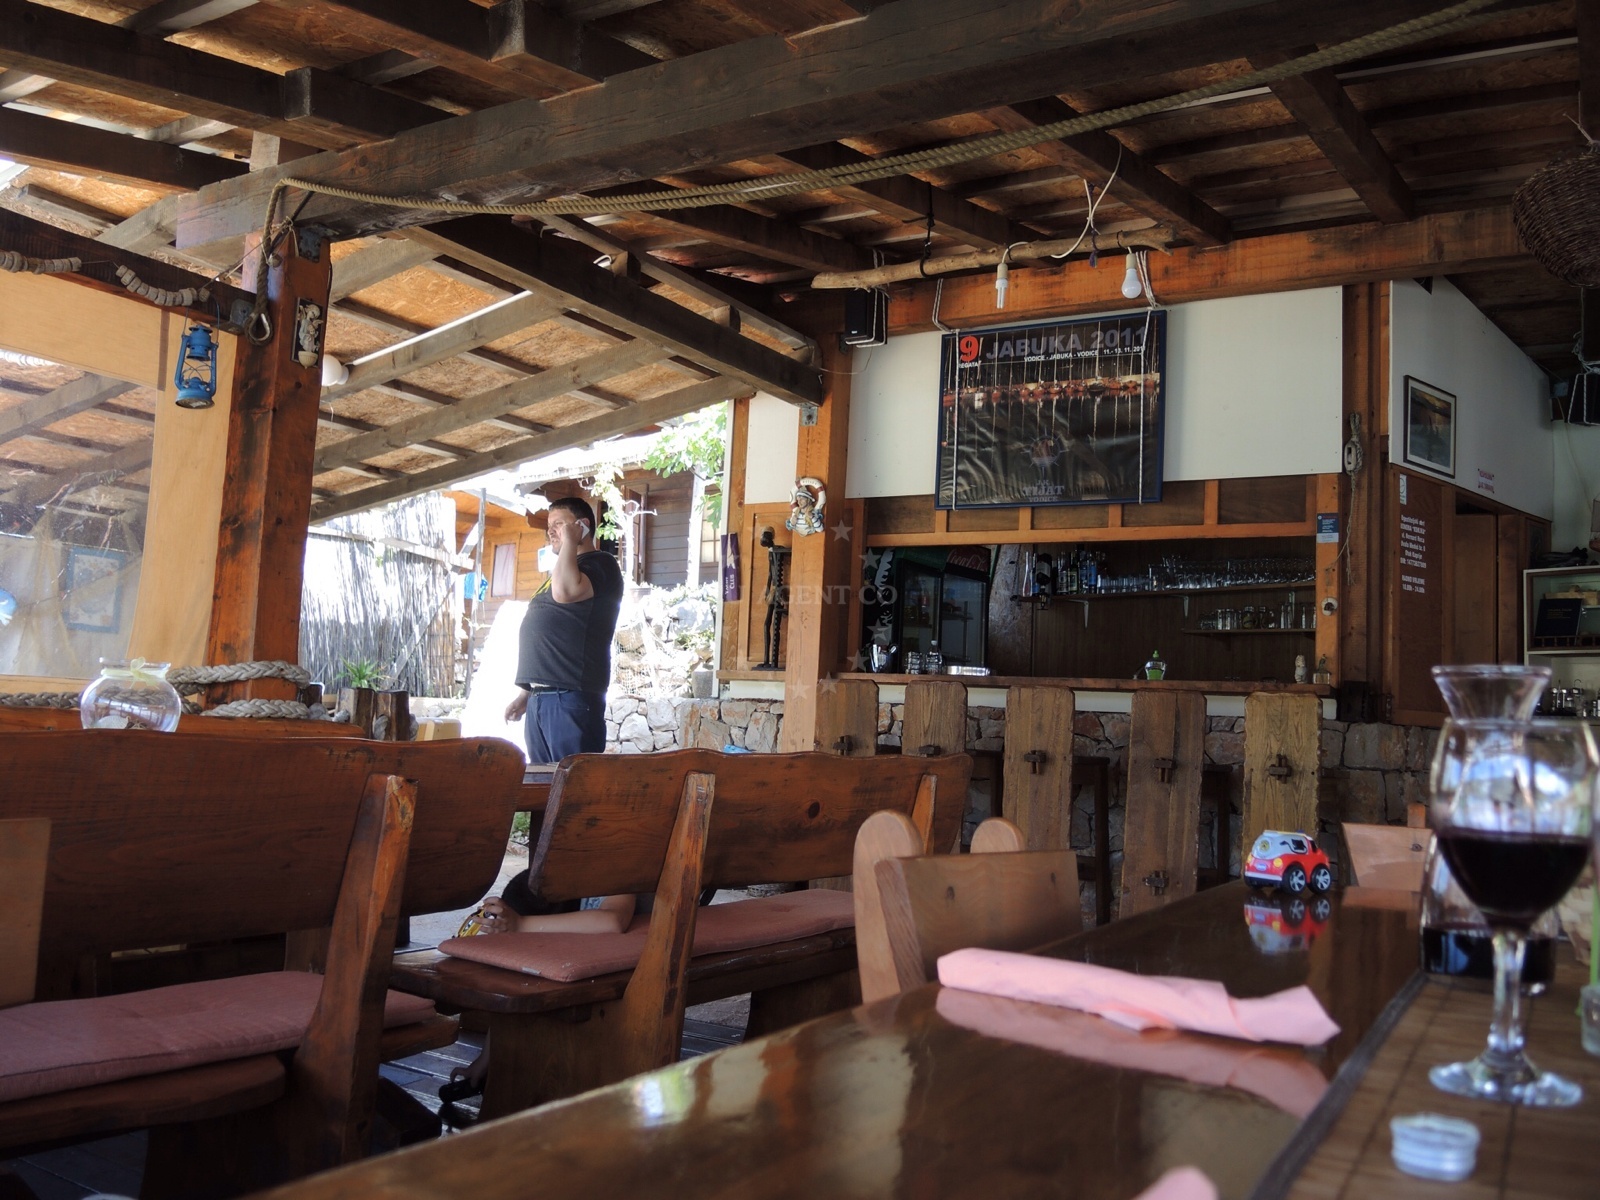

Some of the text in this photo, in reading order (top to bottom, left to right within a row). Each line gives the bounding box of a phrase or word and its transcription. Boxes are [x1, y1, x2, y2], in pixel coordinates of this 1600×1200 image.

[959, 335, 979, 362] 9
[986, 326, 1146, 359] JABUKA 2011
[1024, 355, 1045, 363] VODICE
[1049, 352, 1073, 360] JABUKA
[1077, 350, 1099, 358] VODICE
